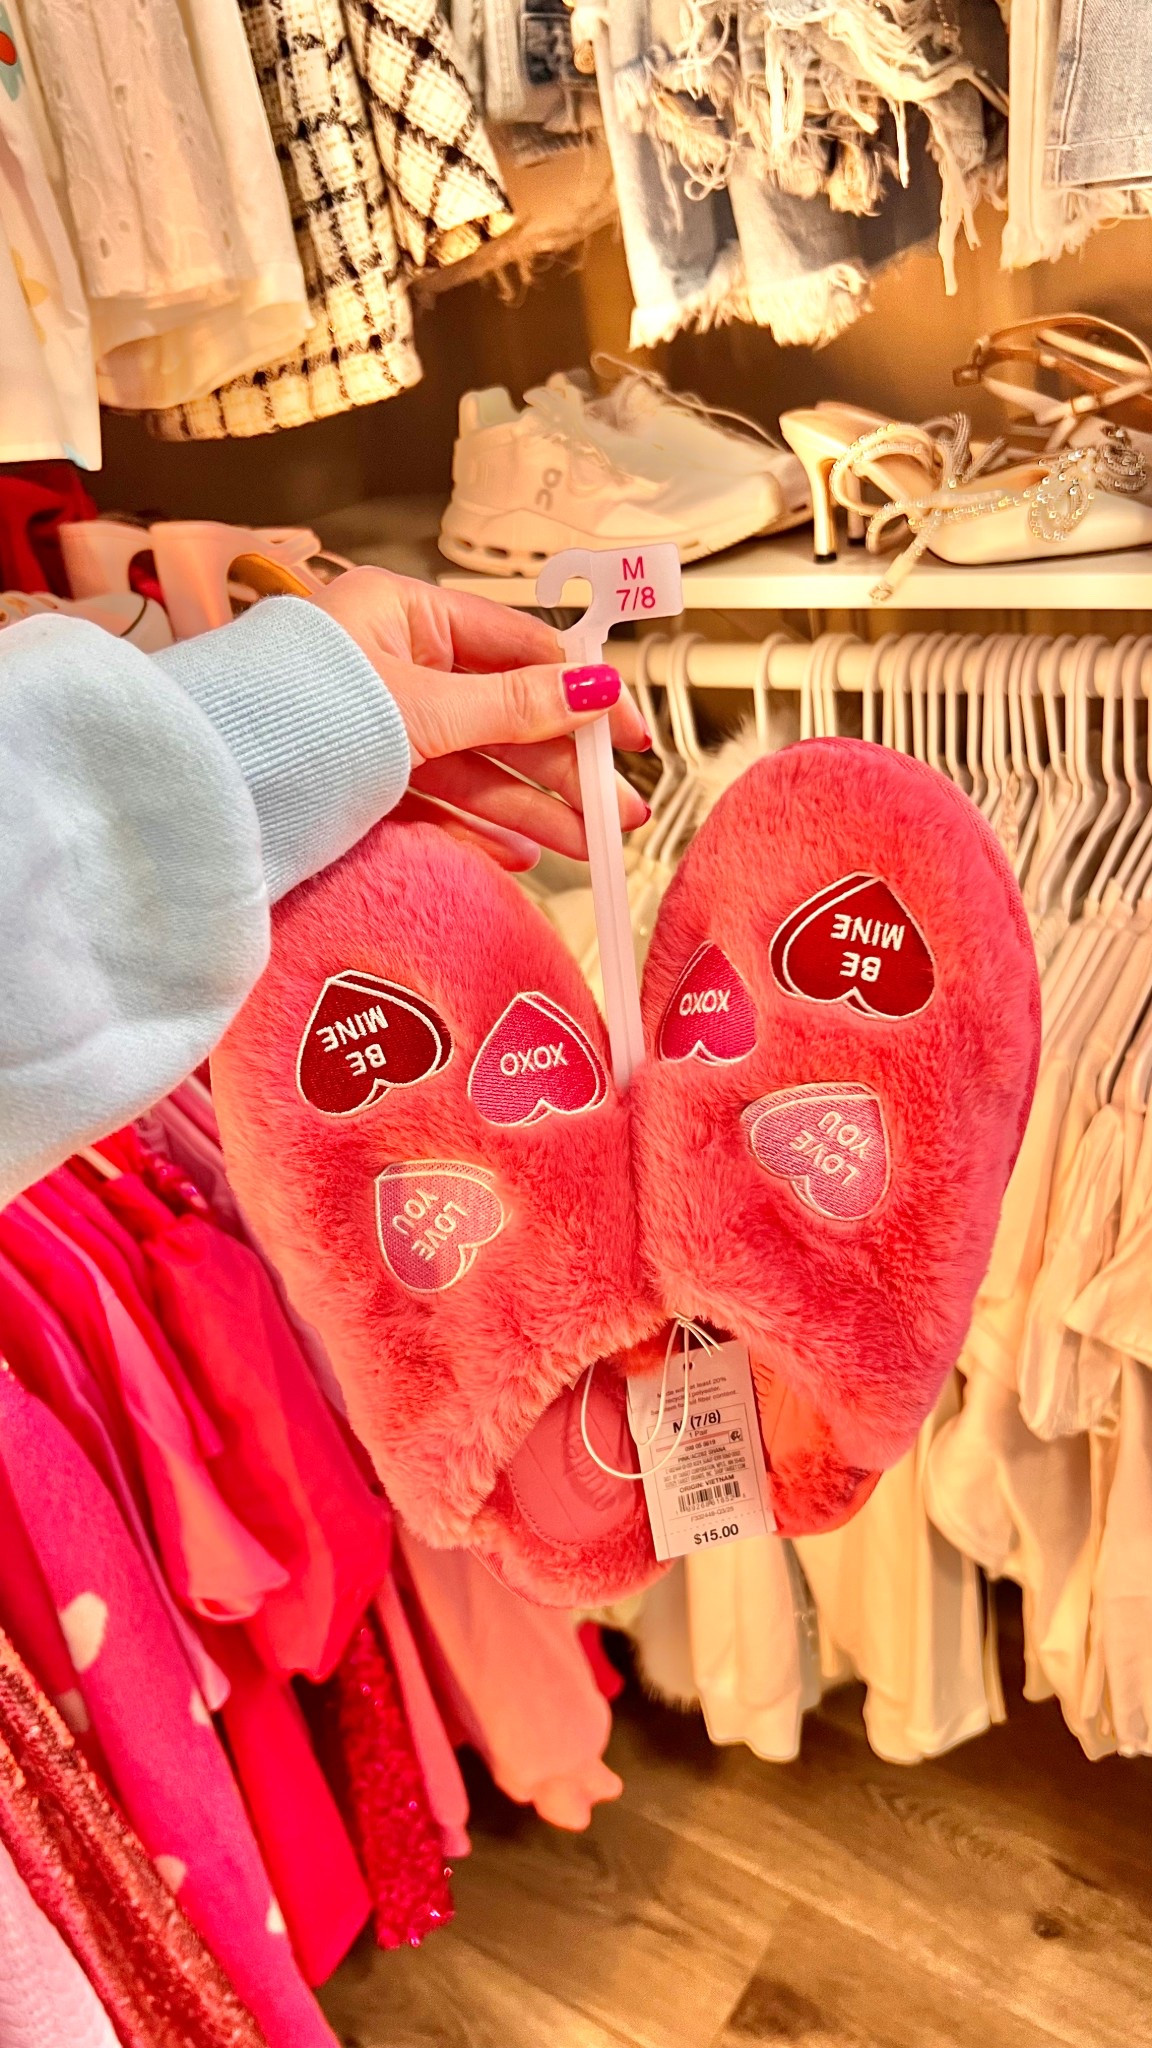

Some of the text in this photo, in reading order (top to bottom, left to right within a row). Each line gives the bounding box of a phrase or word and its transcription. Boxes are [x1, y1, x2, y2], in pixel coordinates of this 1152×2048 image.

[622, 556, 644, 581] M
[616, 586, 656, 611] 7/8
[831, 913, 904, 951] MINE
[840, 951, 881, 982] BE
[679, 989, 731, 1016] XOXO
[316, 1004, 388, 1053] MINE
[346, 1044, 385, 1076] BE
[500, 1042, 568, 1076] XOXO
[817, 1111, 871, 1158] YOU
[791, 1129, 859, 1186] LOVE
[392, 1188, 439, 1236] YOU
[411, 1200, 469, 1262] LOVE
[673, 1410, 722, 1433] M (7/8)
[705, 1474, 734, 1485] VIETNAM
[693, 1524, 739, 1545] $15.00
